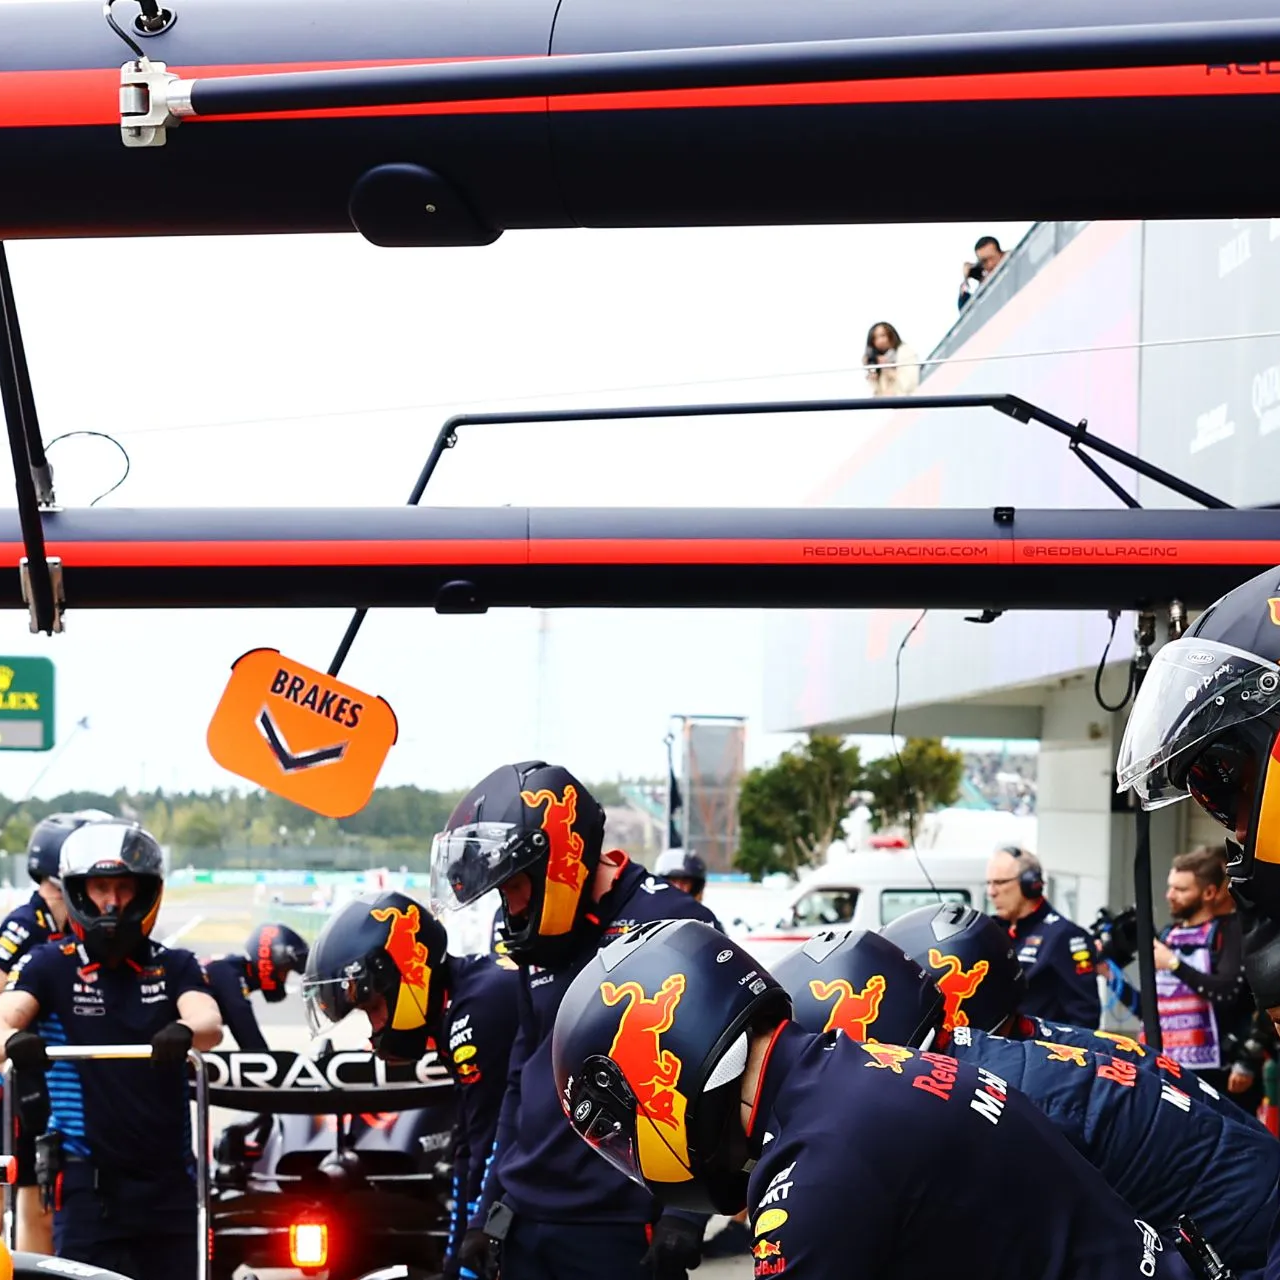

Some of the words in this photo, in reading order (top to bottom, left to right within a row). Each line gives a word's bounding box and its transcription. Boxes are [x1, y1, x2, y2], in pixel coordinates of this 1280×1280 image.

[802, 545, 989, 557] REDBULLRACING.COM
[1022, 545, 1178, 558] @REDBULLRACING
[270, 668, 363, 729] BRAKES
